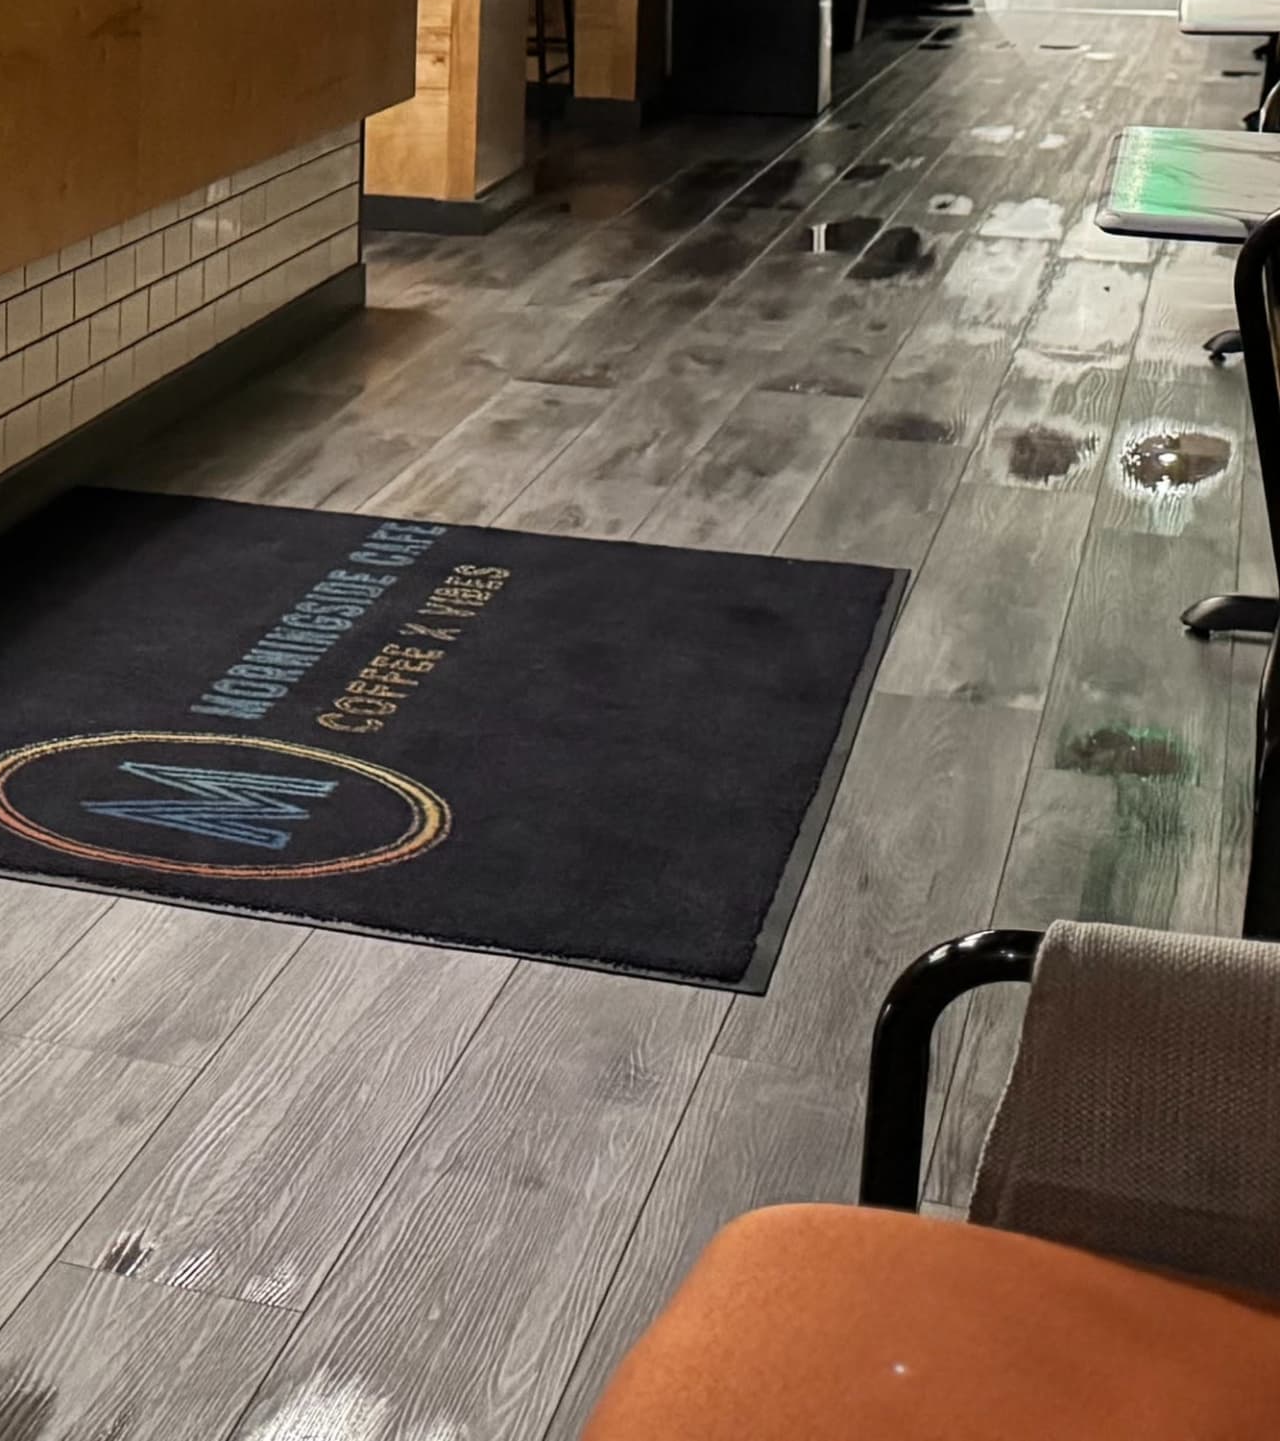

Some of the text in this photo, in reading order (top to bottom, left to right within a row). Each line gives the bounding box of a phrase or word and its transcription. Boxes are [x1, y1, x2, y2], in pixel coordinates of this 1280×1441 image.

[190, 521, 448, 719] MORNINGSIDE CAFE
[316, 564, 511, 734] COFFEE X VIBES
[80, 761, 338, 850] M
